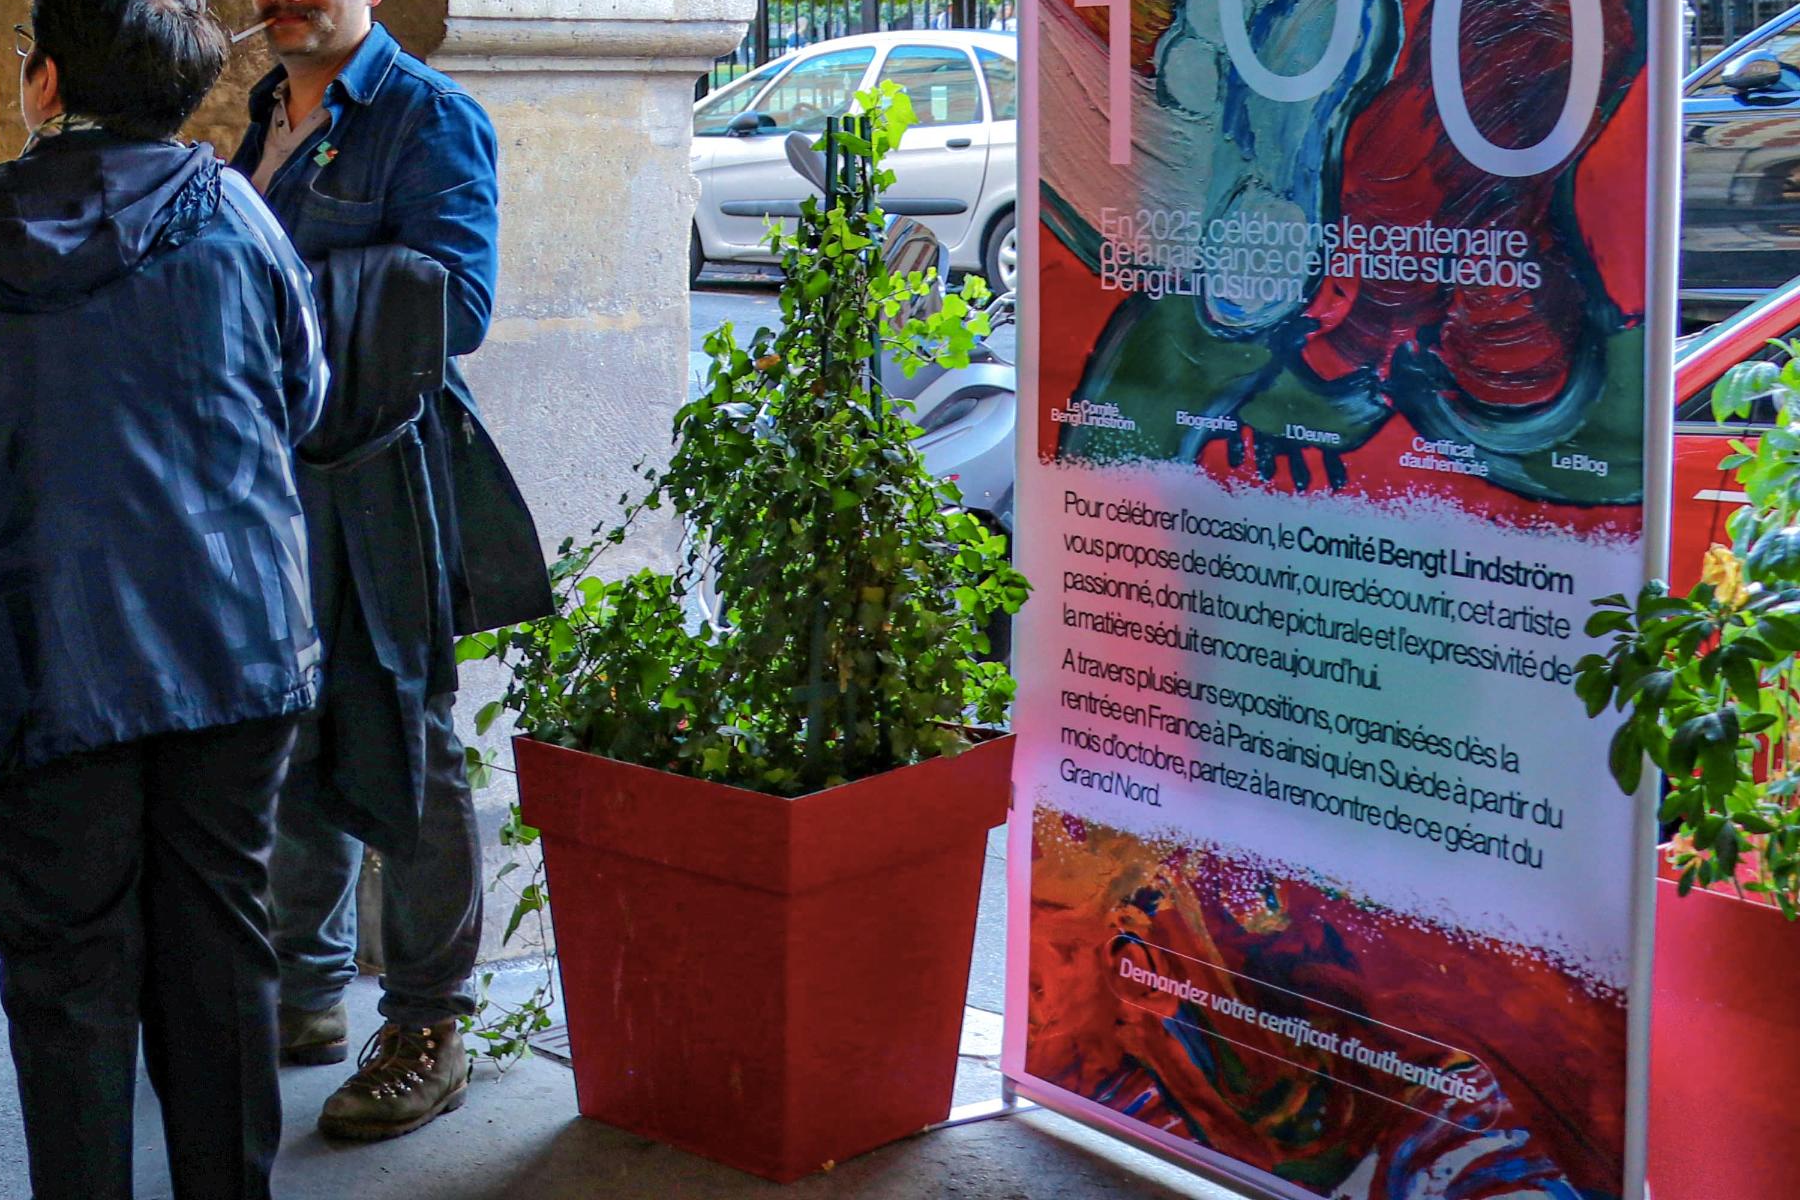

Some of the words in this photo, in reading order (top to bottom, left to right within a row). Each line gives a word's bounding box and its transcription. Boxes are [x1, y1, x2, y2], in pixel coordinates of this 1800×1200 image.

[1101, 208, 1132, 238] En
[1209, 211, 1340, 248] célébrons
[1342, 216, 1367, 250] le
[1369, 220, 1529, 258] centenaire
[1101, 238, 1131, 265] de
[1157, 243, 1283, 273] naissance
[1286, 245, 1321, 276] de
[1101, 263, 1172, 300] Bengt
[1066, 398, 1080, 412] Le
[1080, 400, 1120, 417] Comité
[1176, 410, 1239, 431] Biographie
[1286, 424, 1340, 444] L'Oeuvre
[1412, 436, 1476, 458] Certificat
[1552, 452, 1571, 469] Le
[1573, 454, 1609, 477] Blog
[1064, 490, 1104, 516] Pour
[1106, 499, 1179, 531] célébrer
[1181, 507, 1276, 551] l'occasion,
[1278, 523, 1295, 549] le
[1298, 526, 1376, 563] Comité
[1378, 538, 1447, 578] Bengt
[1450, 548, 1574, 595] Lindström
[1064, 532, 1104, 557] vous
[1106, 539, 1180, 570] propose
[1182, 549, 1206, 575] de
[1209, 554, 1301, 595] découvrir,
[1303, 574, 1329, 597] ou
[1332, 578, 1455, 623] redécouvrir,
[1458, 599, 1495, 626] cet
[1499, 606, 1571, 639] artiste
[1063, 602, 1076, 627] la
[1079, 610, 1142, 640] matière
[1144, 622, 1199, 653] séduit
[1202, 634, 1268, 671] encore
[1271, 650, 1382, 691] aujourd'hui.
[1064, 570, 1154, 608] passionné,
[1157, 584, 1197, 613] dont
[1200, 593, 1215, 617] la
[1218, 599, 1284, 625] touche
[1286, 608, 1373, 646] picturale
[1375, 625, 1396, 651] et
[1398, 626, 1537, 678] l'expressivité
[1540, 655, 1573, 685] de
[1061, 648, 1076, 673] A
[1078, 654, 1135, 685] travers
[1137, 666, 1217, 705] plusieurs
[1220, 687, 1332, 734] expositions,
[1334, 713, 1452, 758] organisées
[1455, 735, 1497, 769] dès
[1501, 743, 1520, 774] la
[1060, 757, 1113, 794] Grand
[1115, 774, 1162, 807] Nord.
[1061, 688, 1121, 720] rentrée
[1124, 704, 1146, 728] en
[1148, 704, 1211, 741] France
[1213, 719, 1225, 747] à
[1228, 722, 1274, 758] Paris
[1277, 737, 1320, 768] ainsi
[1322, 751, 1376, 783] qu'en
[1379, 758, 1451, 800] Suède
[1453, 776, 1467, 805] à
[1470, 787, 1529, 819] partir
[1532, 798, 1563, 830] du
[1061, 726, 1101, 752] mois
[1103, 733, 1187, 779] d'octobre,
[1189, 759, 1248, 792] partez
[1251, 768, 1262, 795] à
[1265, 772, 1280, 801] la
[1283, 784, 1382, 826] rencontre
[1384, 805, 1412, 835] de
[1414, 817, 1442, 843] ce
[1445, 822, 1509, 861] géant
[1512, 838, 1543, 870] du
[1119, 957, 1208, 1008] Demandez
[1211, 992, 1257, 1024] votre
[1258, 1010, 1339, 1055] certificat
[1340, 1037, 1477, 1104] d'authenticité
